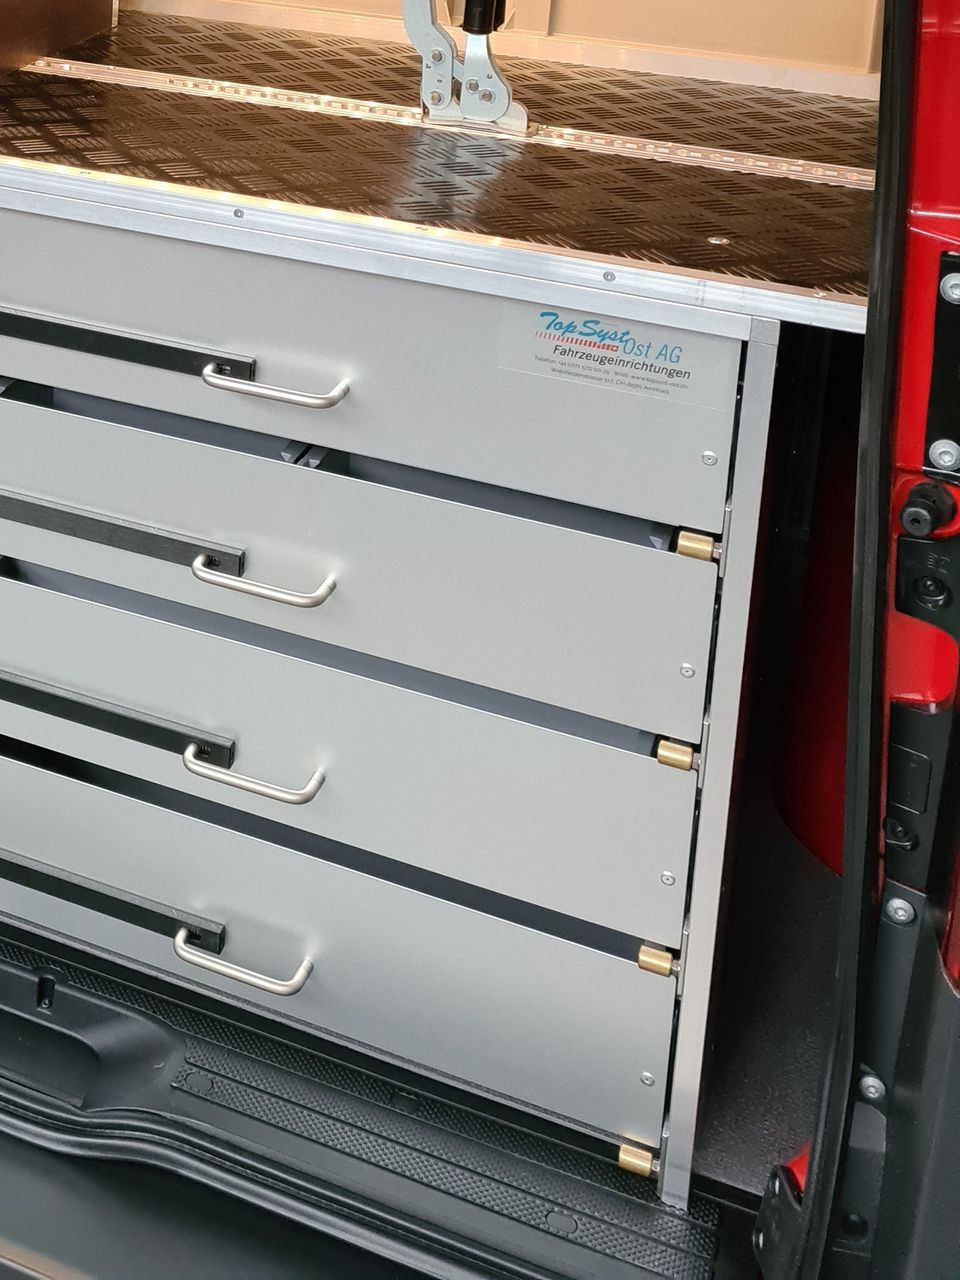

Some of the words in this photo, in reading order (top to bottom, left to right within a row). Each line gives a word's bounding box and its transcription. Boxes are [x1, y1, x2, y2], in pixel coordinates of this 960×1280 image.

[552, 344, 692, 380] Fahrzeugeinrichtungen
[623, 337, 653, 358] Ost
[655, 344, 683, 364] AG
